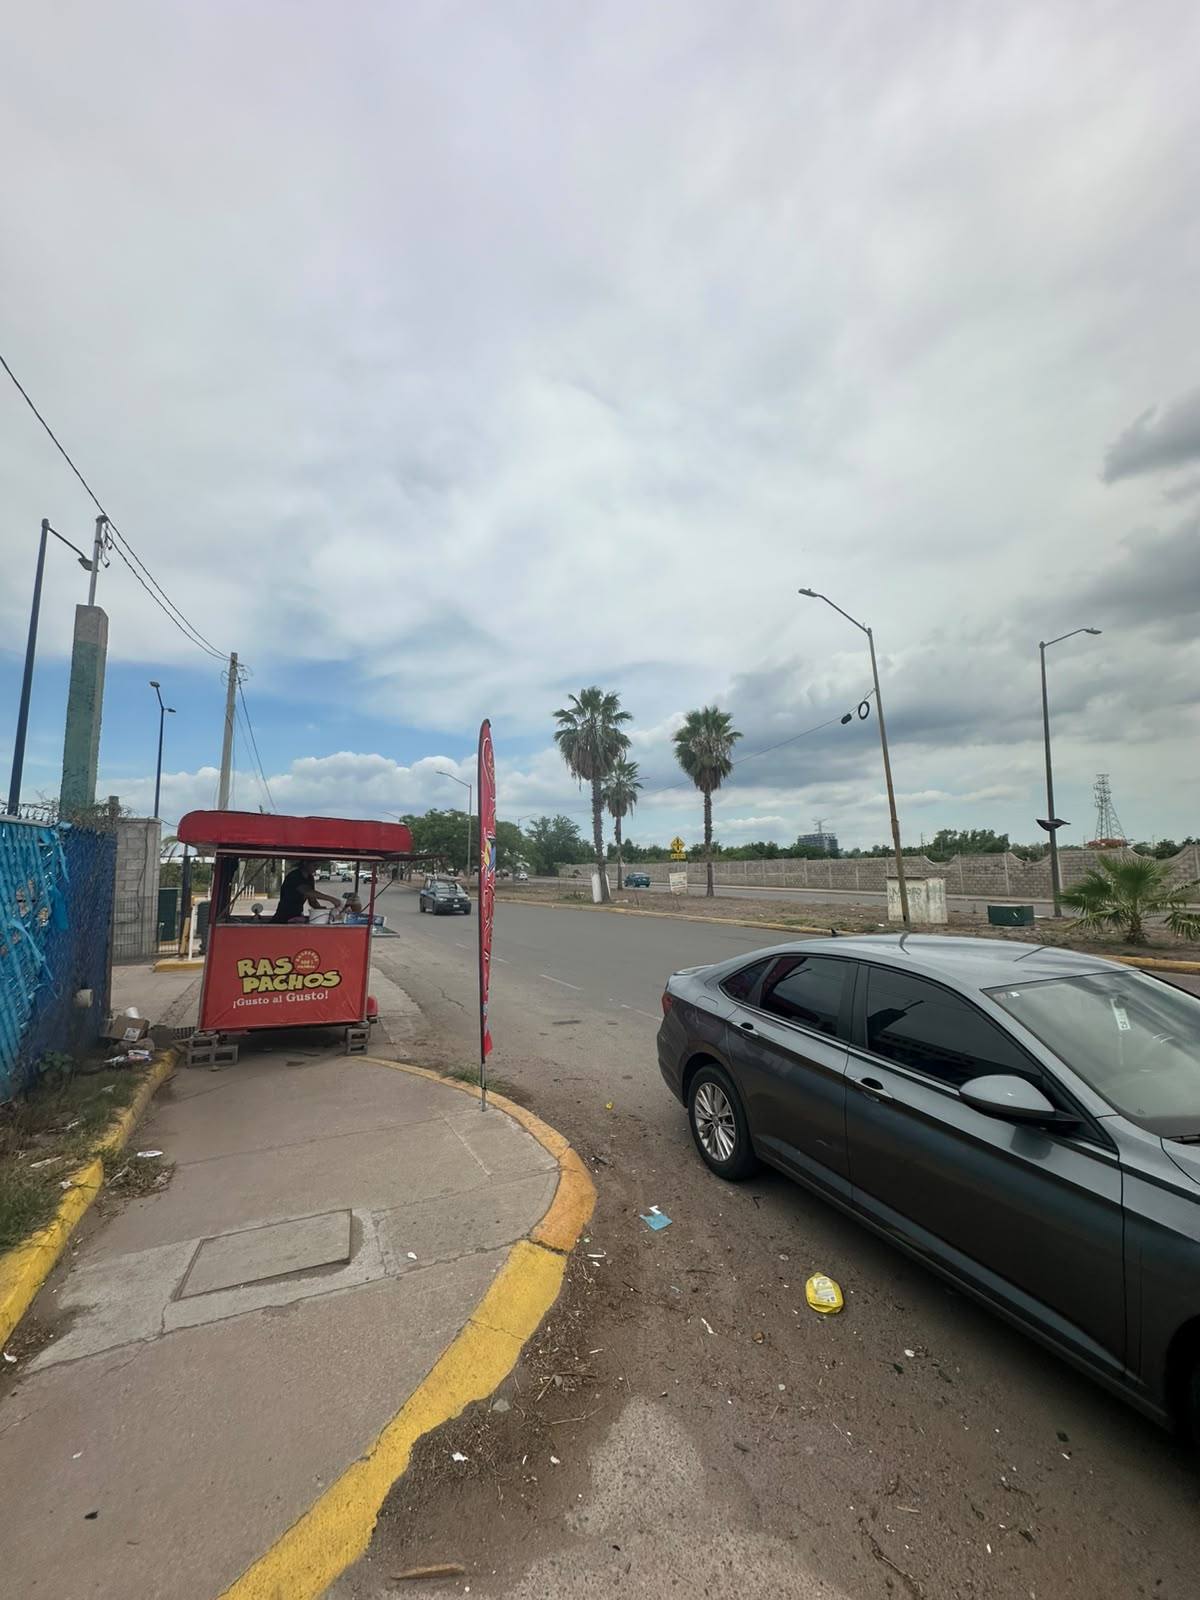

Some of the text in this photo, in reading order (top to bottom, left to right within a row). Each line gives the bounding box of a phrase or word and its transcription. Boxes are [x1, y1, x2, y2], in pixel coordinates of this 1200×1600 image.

[237, 957, 293, 977] RAS
[242, 970, 341, 994] PACHOS
[232, 990, 329, 1009] ¡Gusto al Gusto!
